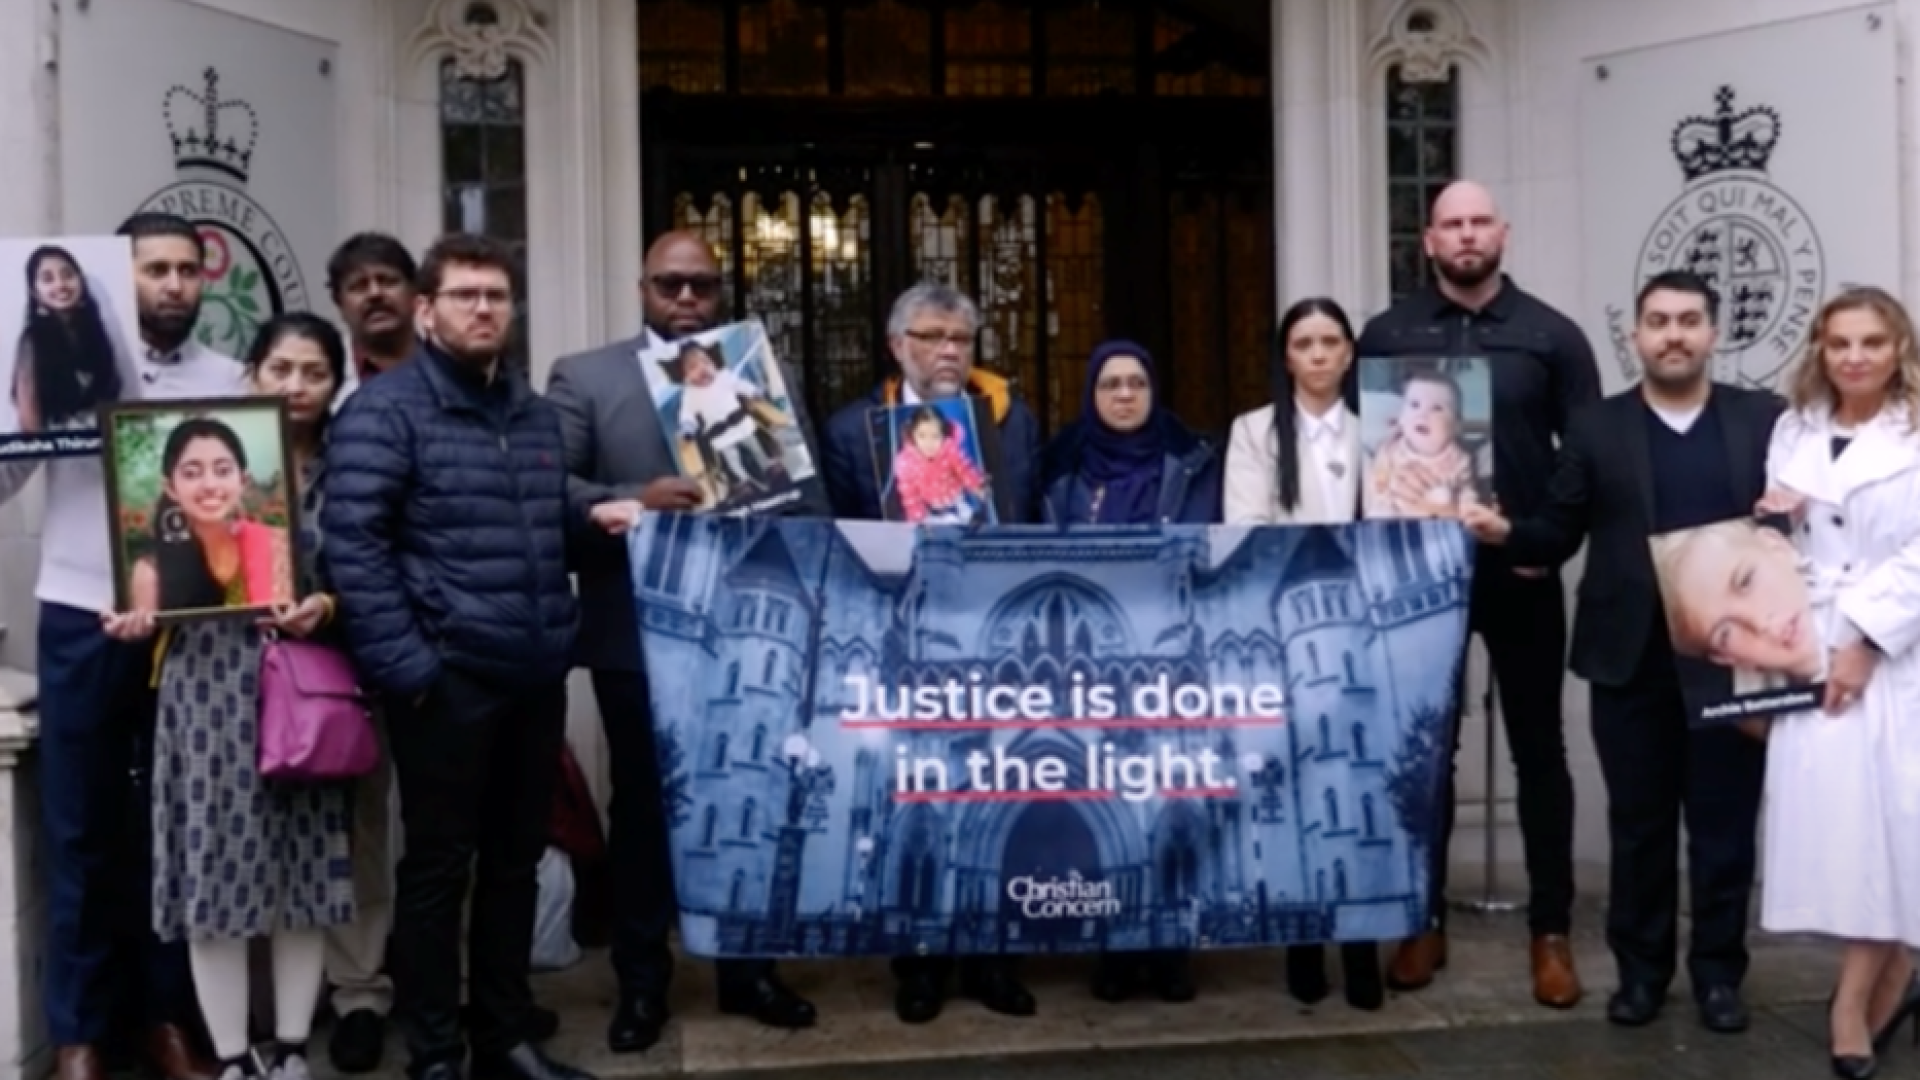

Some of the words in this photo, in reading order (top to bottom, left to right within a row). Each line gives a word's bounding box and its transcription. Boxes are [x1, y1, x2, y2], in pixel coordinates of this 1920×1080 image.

[1698, 186, 1747, 214] QUI
[1752, 191, 1798, 240] MAL
[153, 189, 255, 230] PREME
[261, 230, 305, 308] COU
[1648, 204, 1690, 266] SOIT
[1794, 238, 1813, 256] Y
[1768, 268, 1816, 355] PENSE
[841, 672, 1054, 722] Justice
[1071, 671, 1118, 720] is
[1132, 672, 1284, 719] done
[896, 743, 949, 793] in
[965, 744, 1069, 792] the
[1087, 741, 1237, 802] light.
[1006, 870, 1111, 901] Christian
[1021, 897, 1121, 918] Concern
